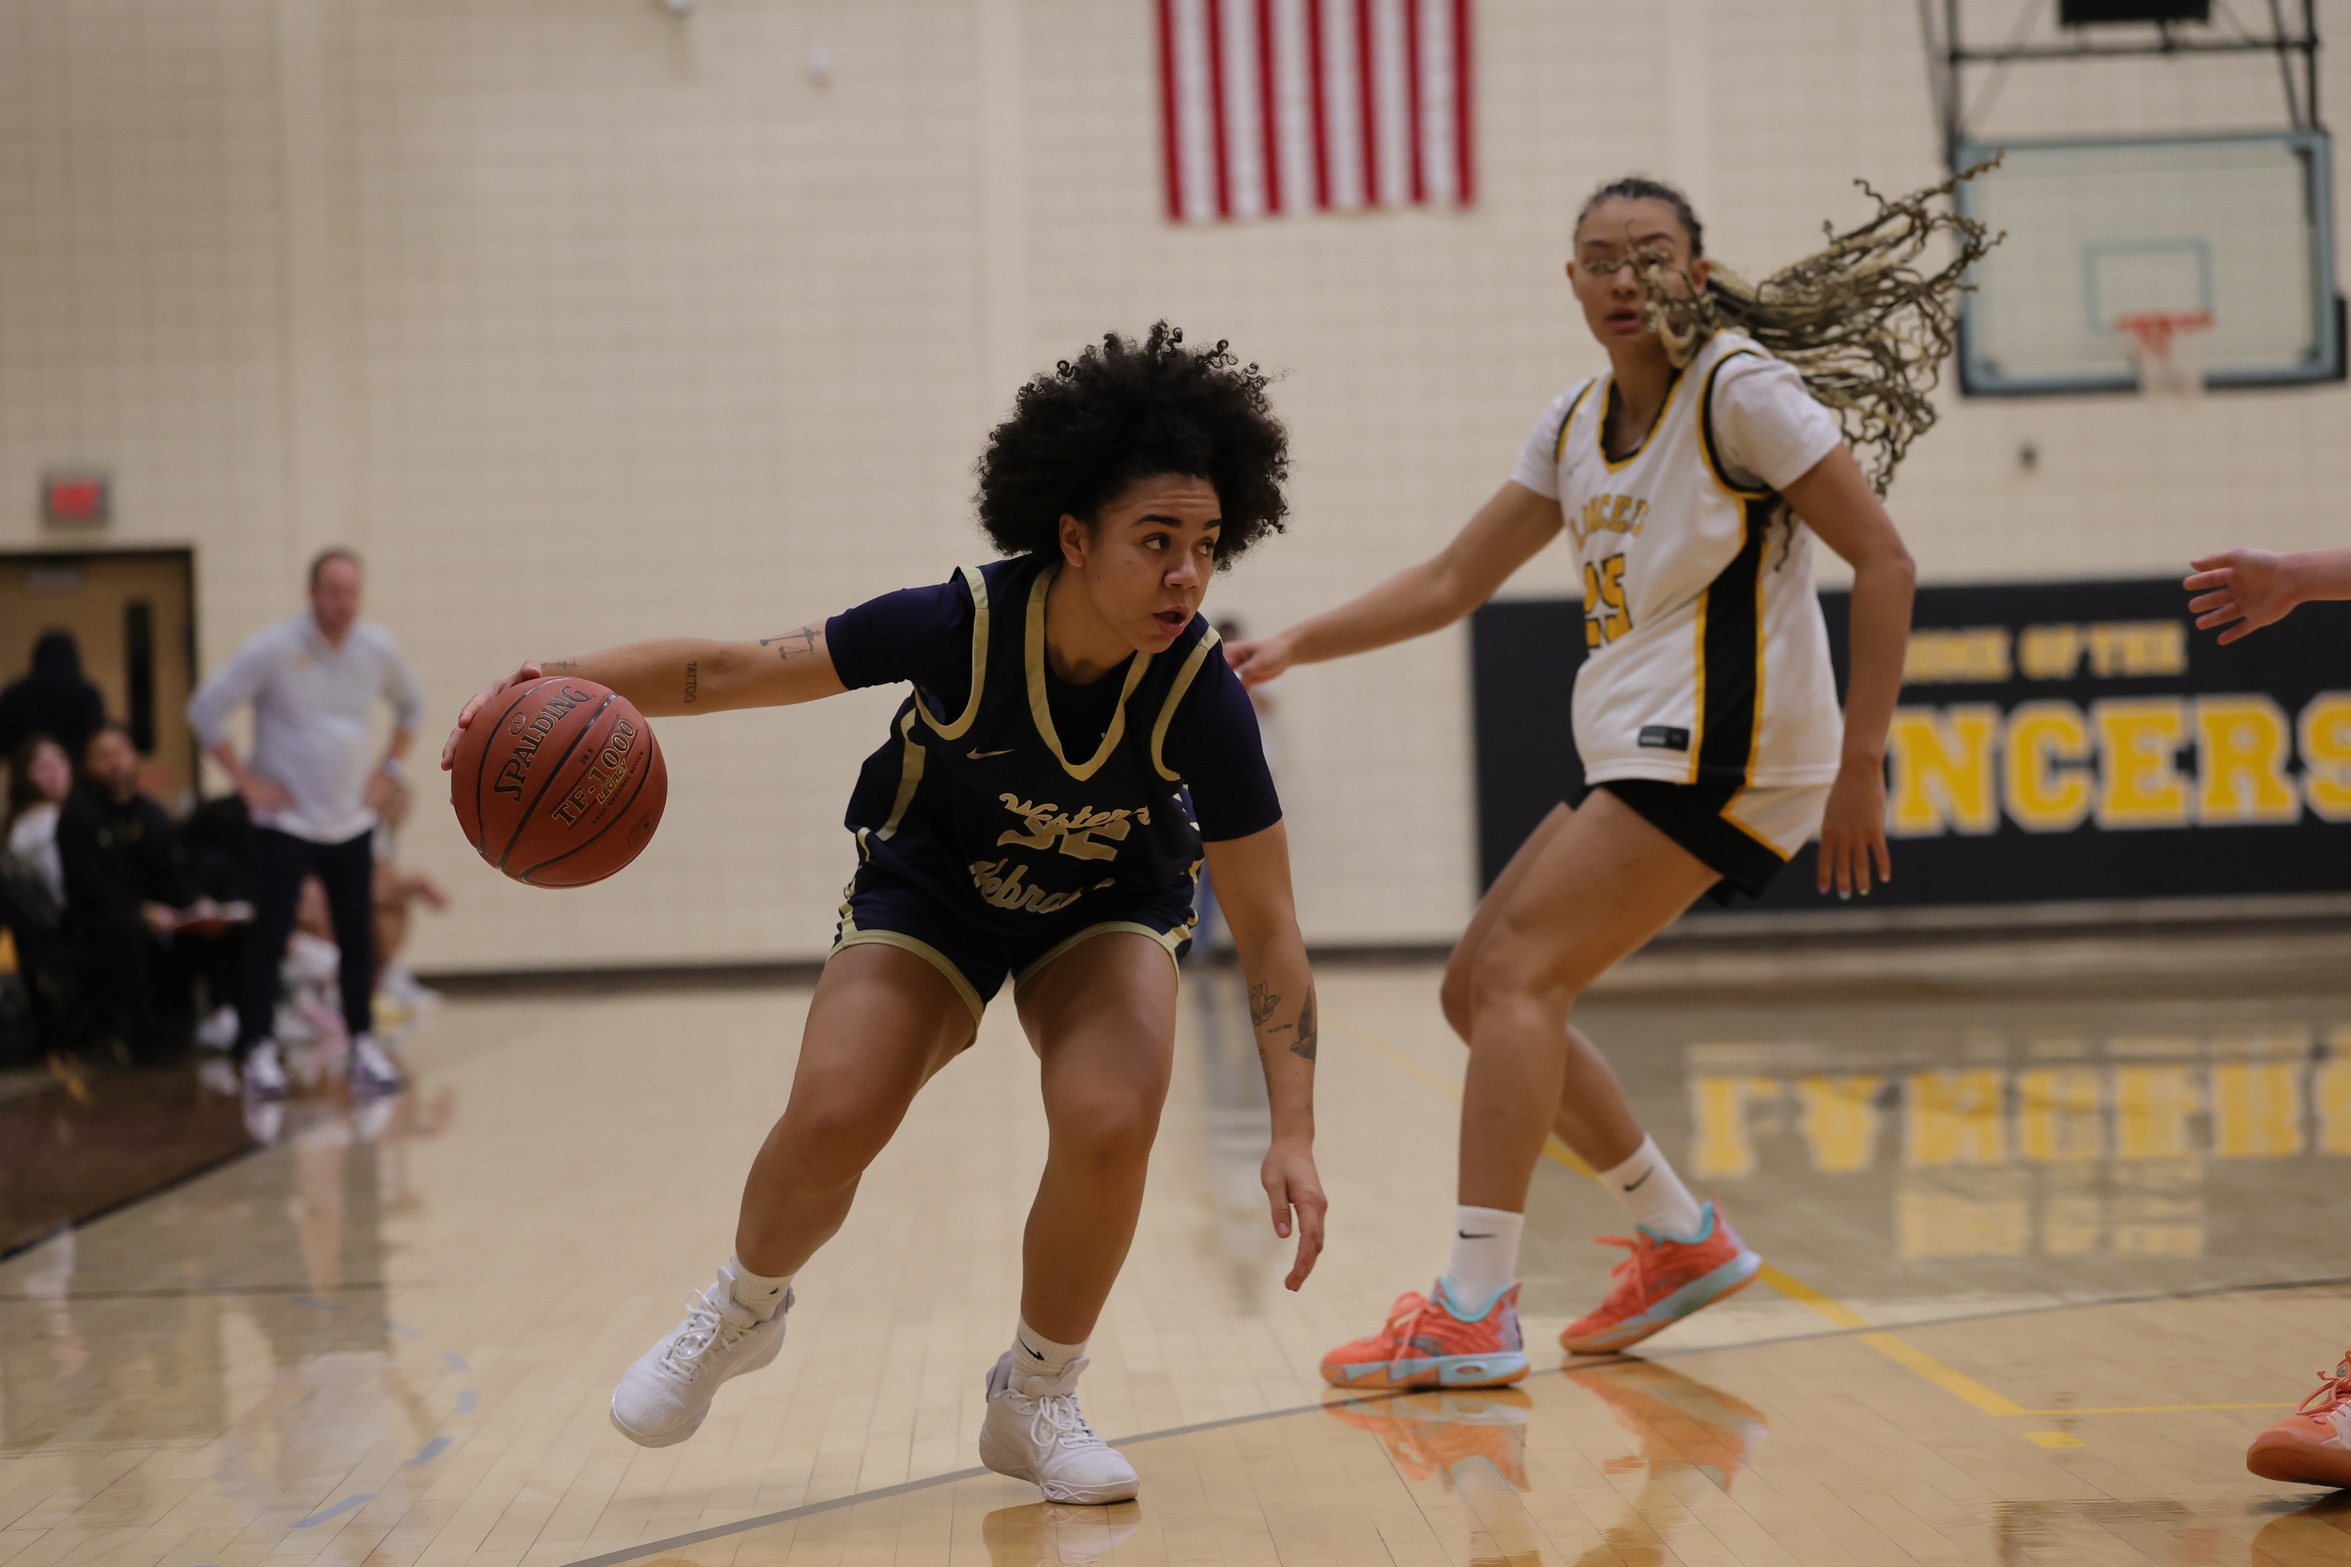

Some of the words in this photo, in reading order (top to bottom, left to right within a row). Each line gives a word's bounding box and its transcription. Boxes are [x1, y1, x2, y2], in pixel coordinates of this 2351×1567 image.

[494, 685, 593, 803] SPALDING
[552, 718, 636, 827] TF-1000
[596, 758, 629, 805] LEGACY
[1888, 690, 2351, 838] NCERS
